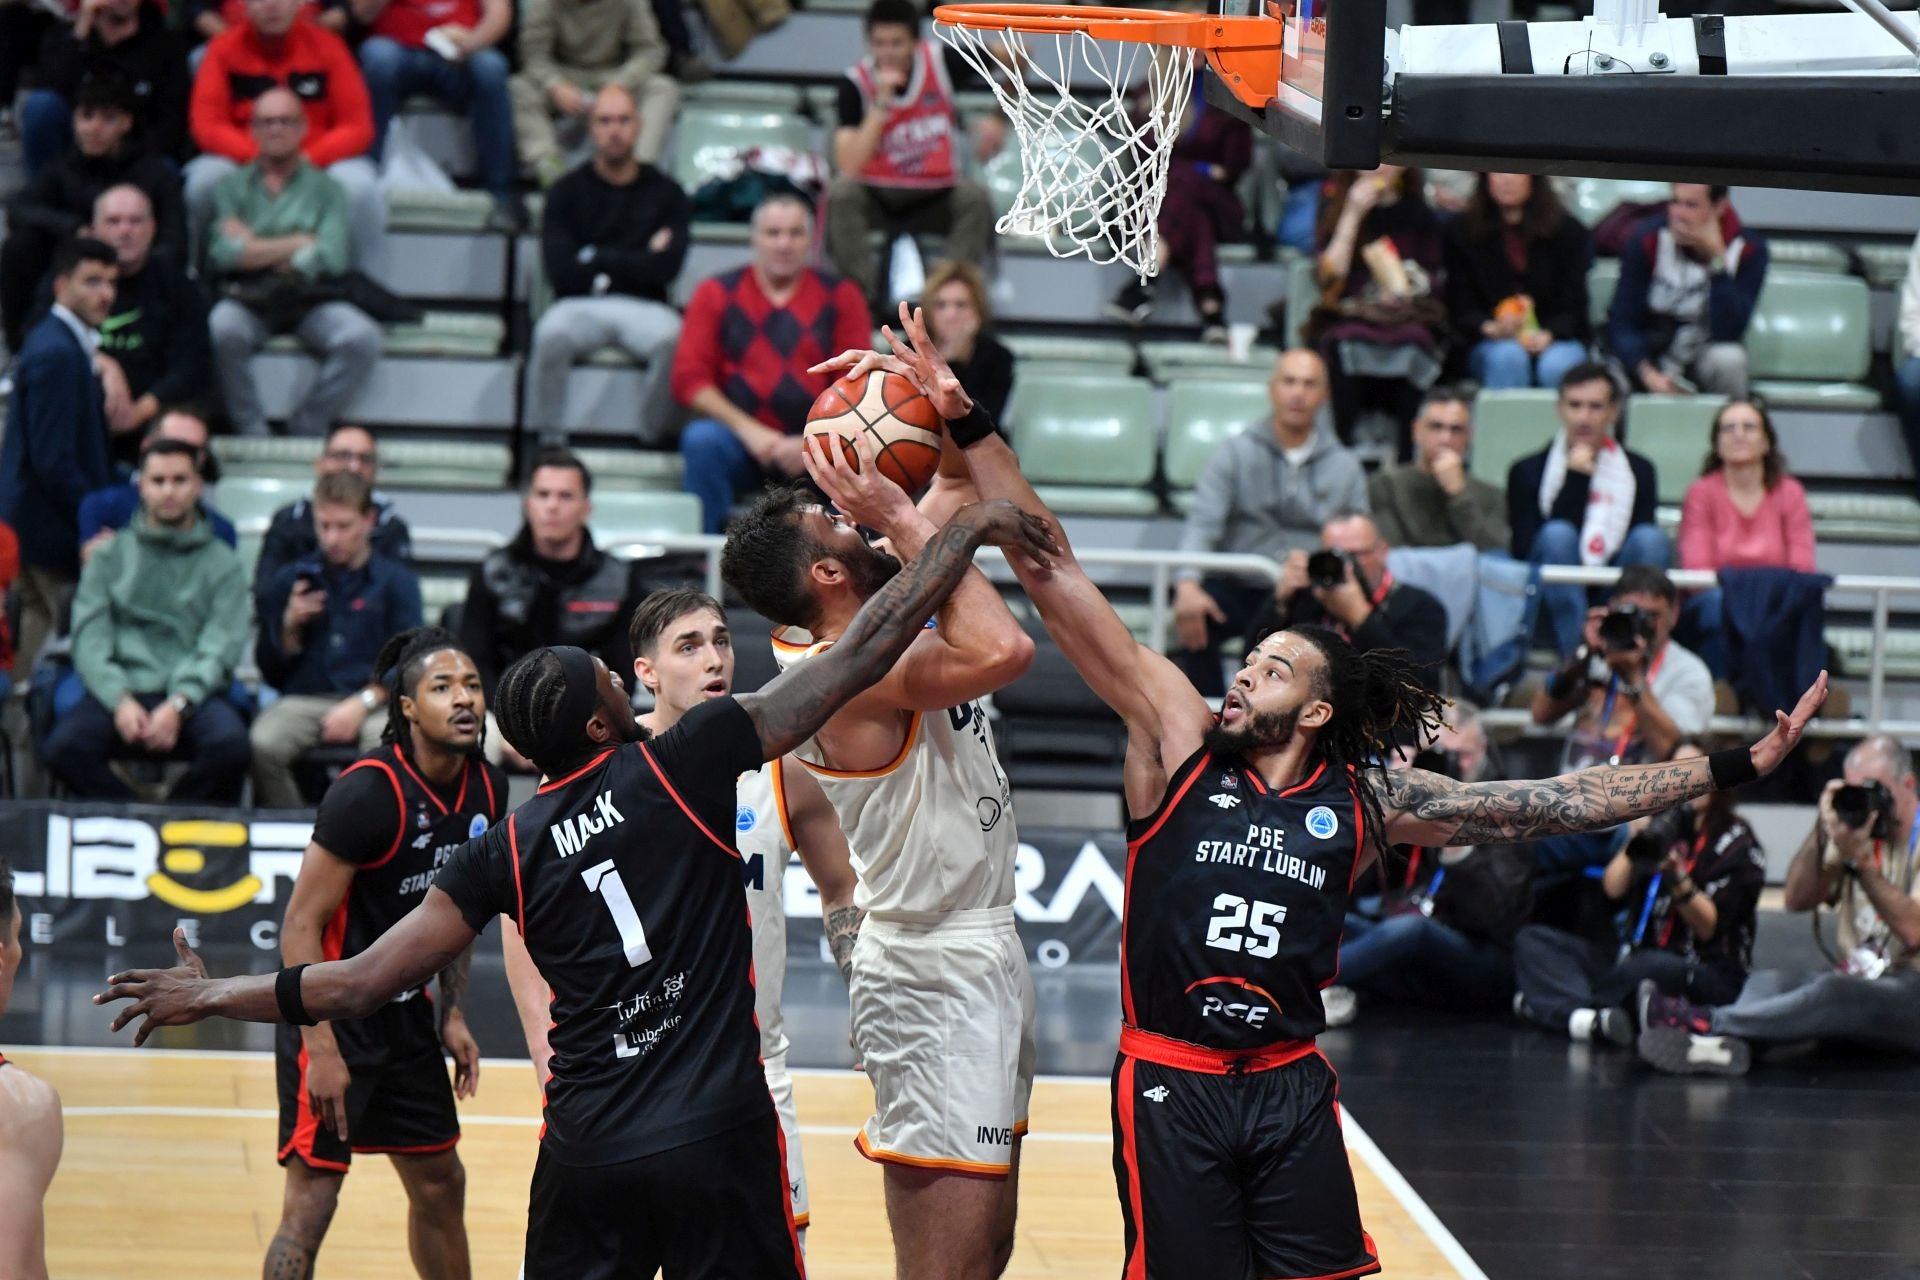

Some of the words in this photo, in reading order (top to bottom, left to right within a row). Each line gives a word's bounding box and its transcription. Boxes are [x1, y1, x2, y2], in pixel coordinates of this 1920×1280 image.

[1607, 782, 1641, 802] through
[1643, 780, 1676, 795] Christ
[1620, 775, 1634, 783] can
[1639, 771, 1648, 781] do
[1652, 770, 1665, 781] all
[1670, 767, 1692, 783] things
[550, 790, 625, 858] MACK
[1246, 824, 1285, 850] PGE
[1196, 840, 1260, 868] START
[1263, 850, 1326, 890] LUBLIN
[580, 858, 653, 968] 1
[1206, 893, 1288, 959] 25
